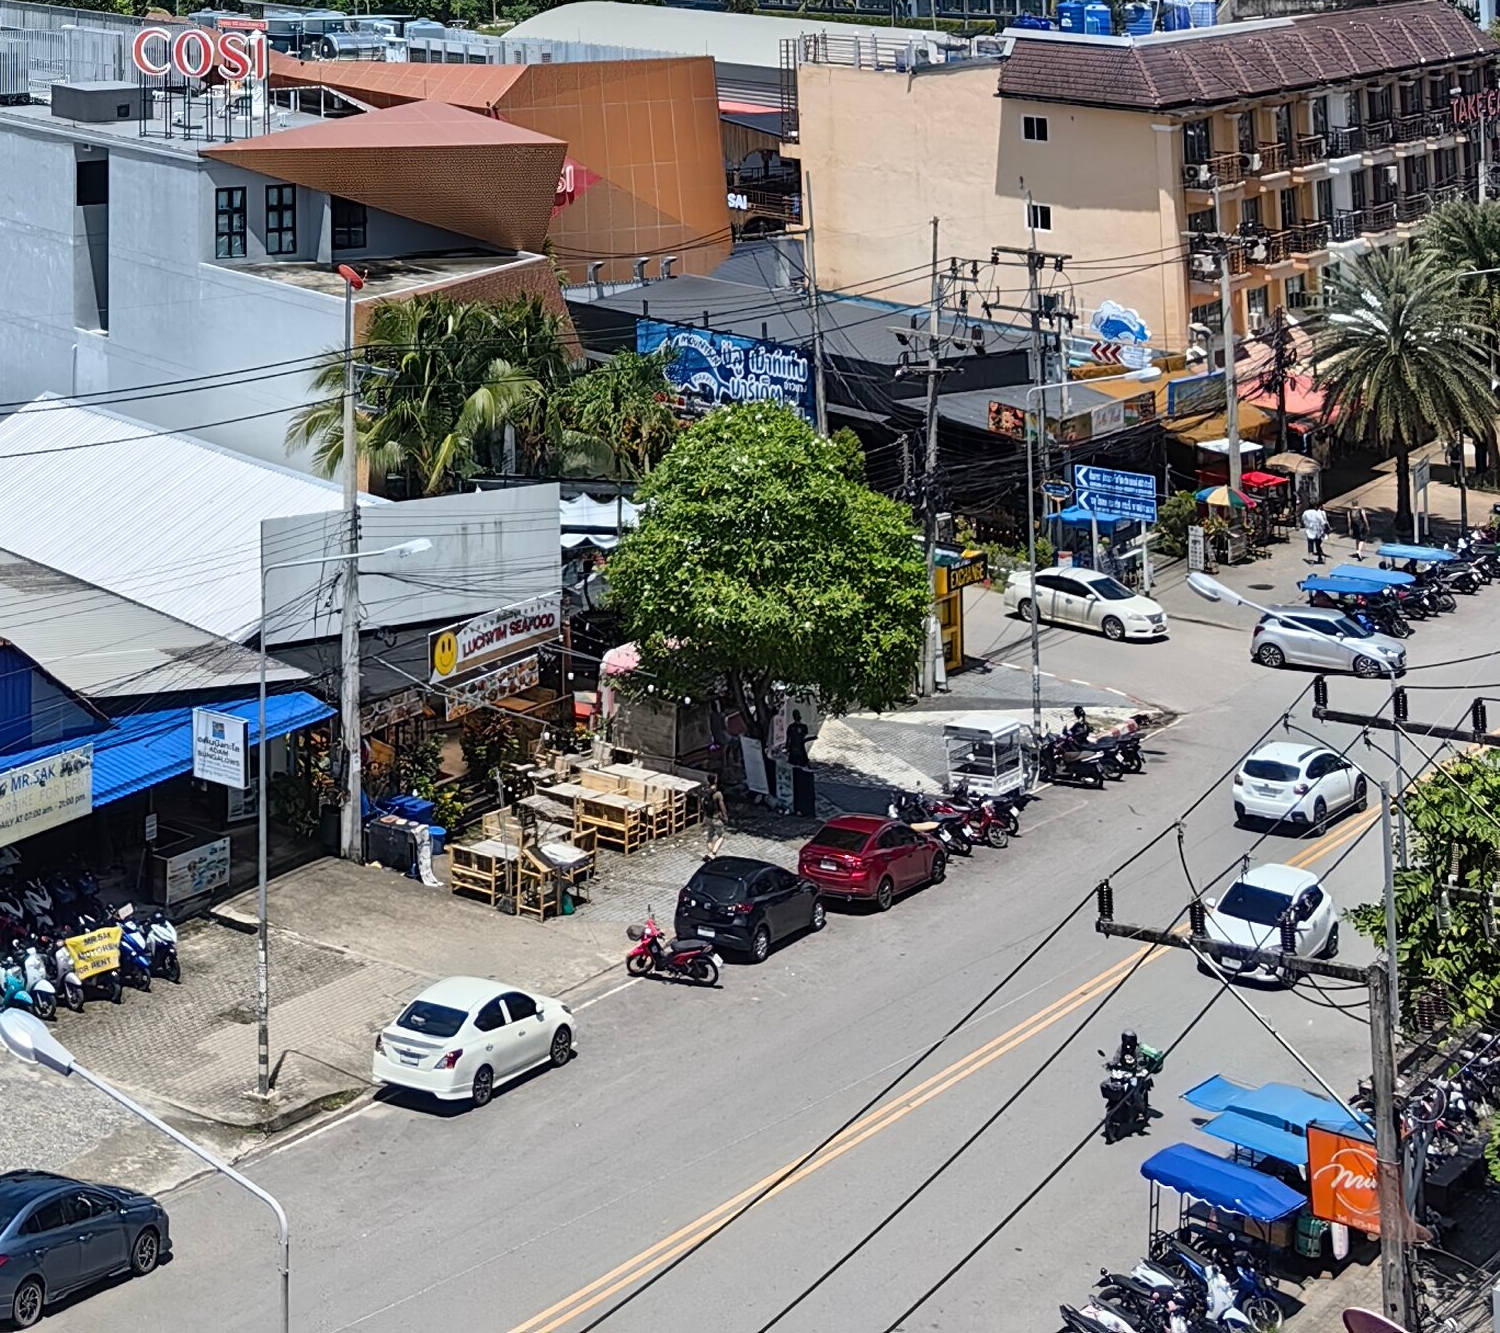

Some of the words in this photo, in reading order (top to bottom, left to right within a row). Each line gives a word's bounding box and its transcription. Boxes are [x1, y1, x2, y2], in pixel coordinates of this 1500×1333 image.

[133, 27, 267, 81] COSI
[1450, 92, 1486, 123] TAKE
[509, 613, 555, 636] SEAFOOD
[11, 763, 57, 792] MR.SAK
[39, 785, 61, 803] FOR
[65, 773, 90, 793] RENT
